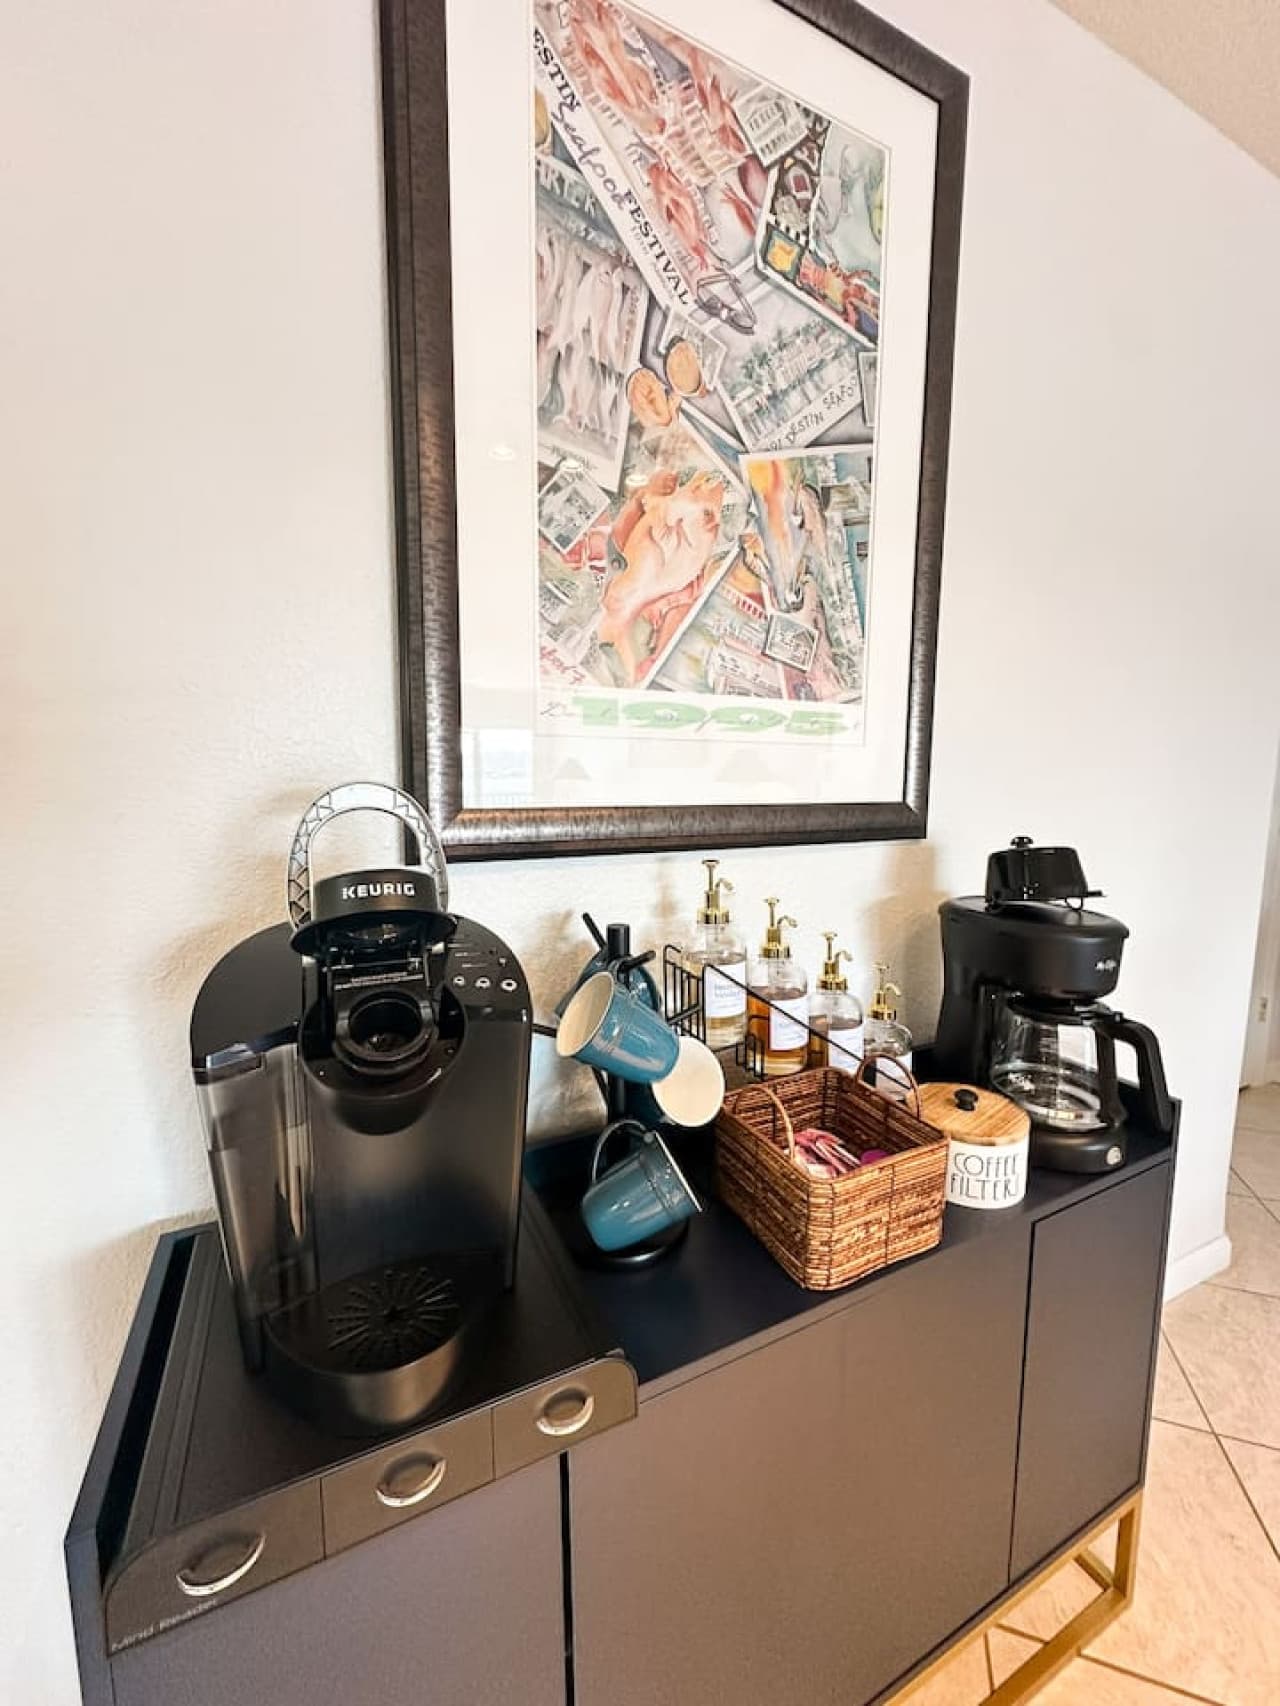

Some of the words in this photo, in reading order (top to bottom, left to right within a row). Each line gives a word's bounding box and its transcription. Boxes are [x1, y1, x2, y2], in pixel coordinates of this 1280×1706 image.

[624, 189, 689, 304] FESTIVAL
[342, 882, 415, 900] KEURIG
[954, 1153, 1019, 1178] COFFEE
